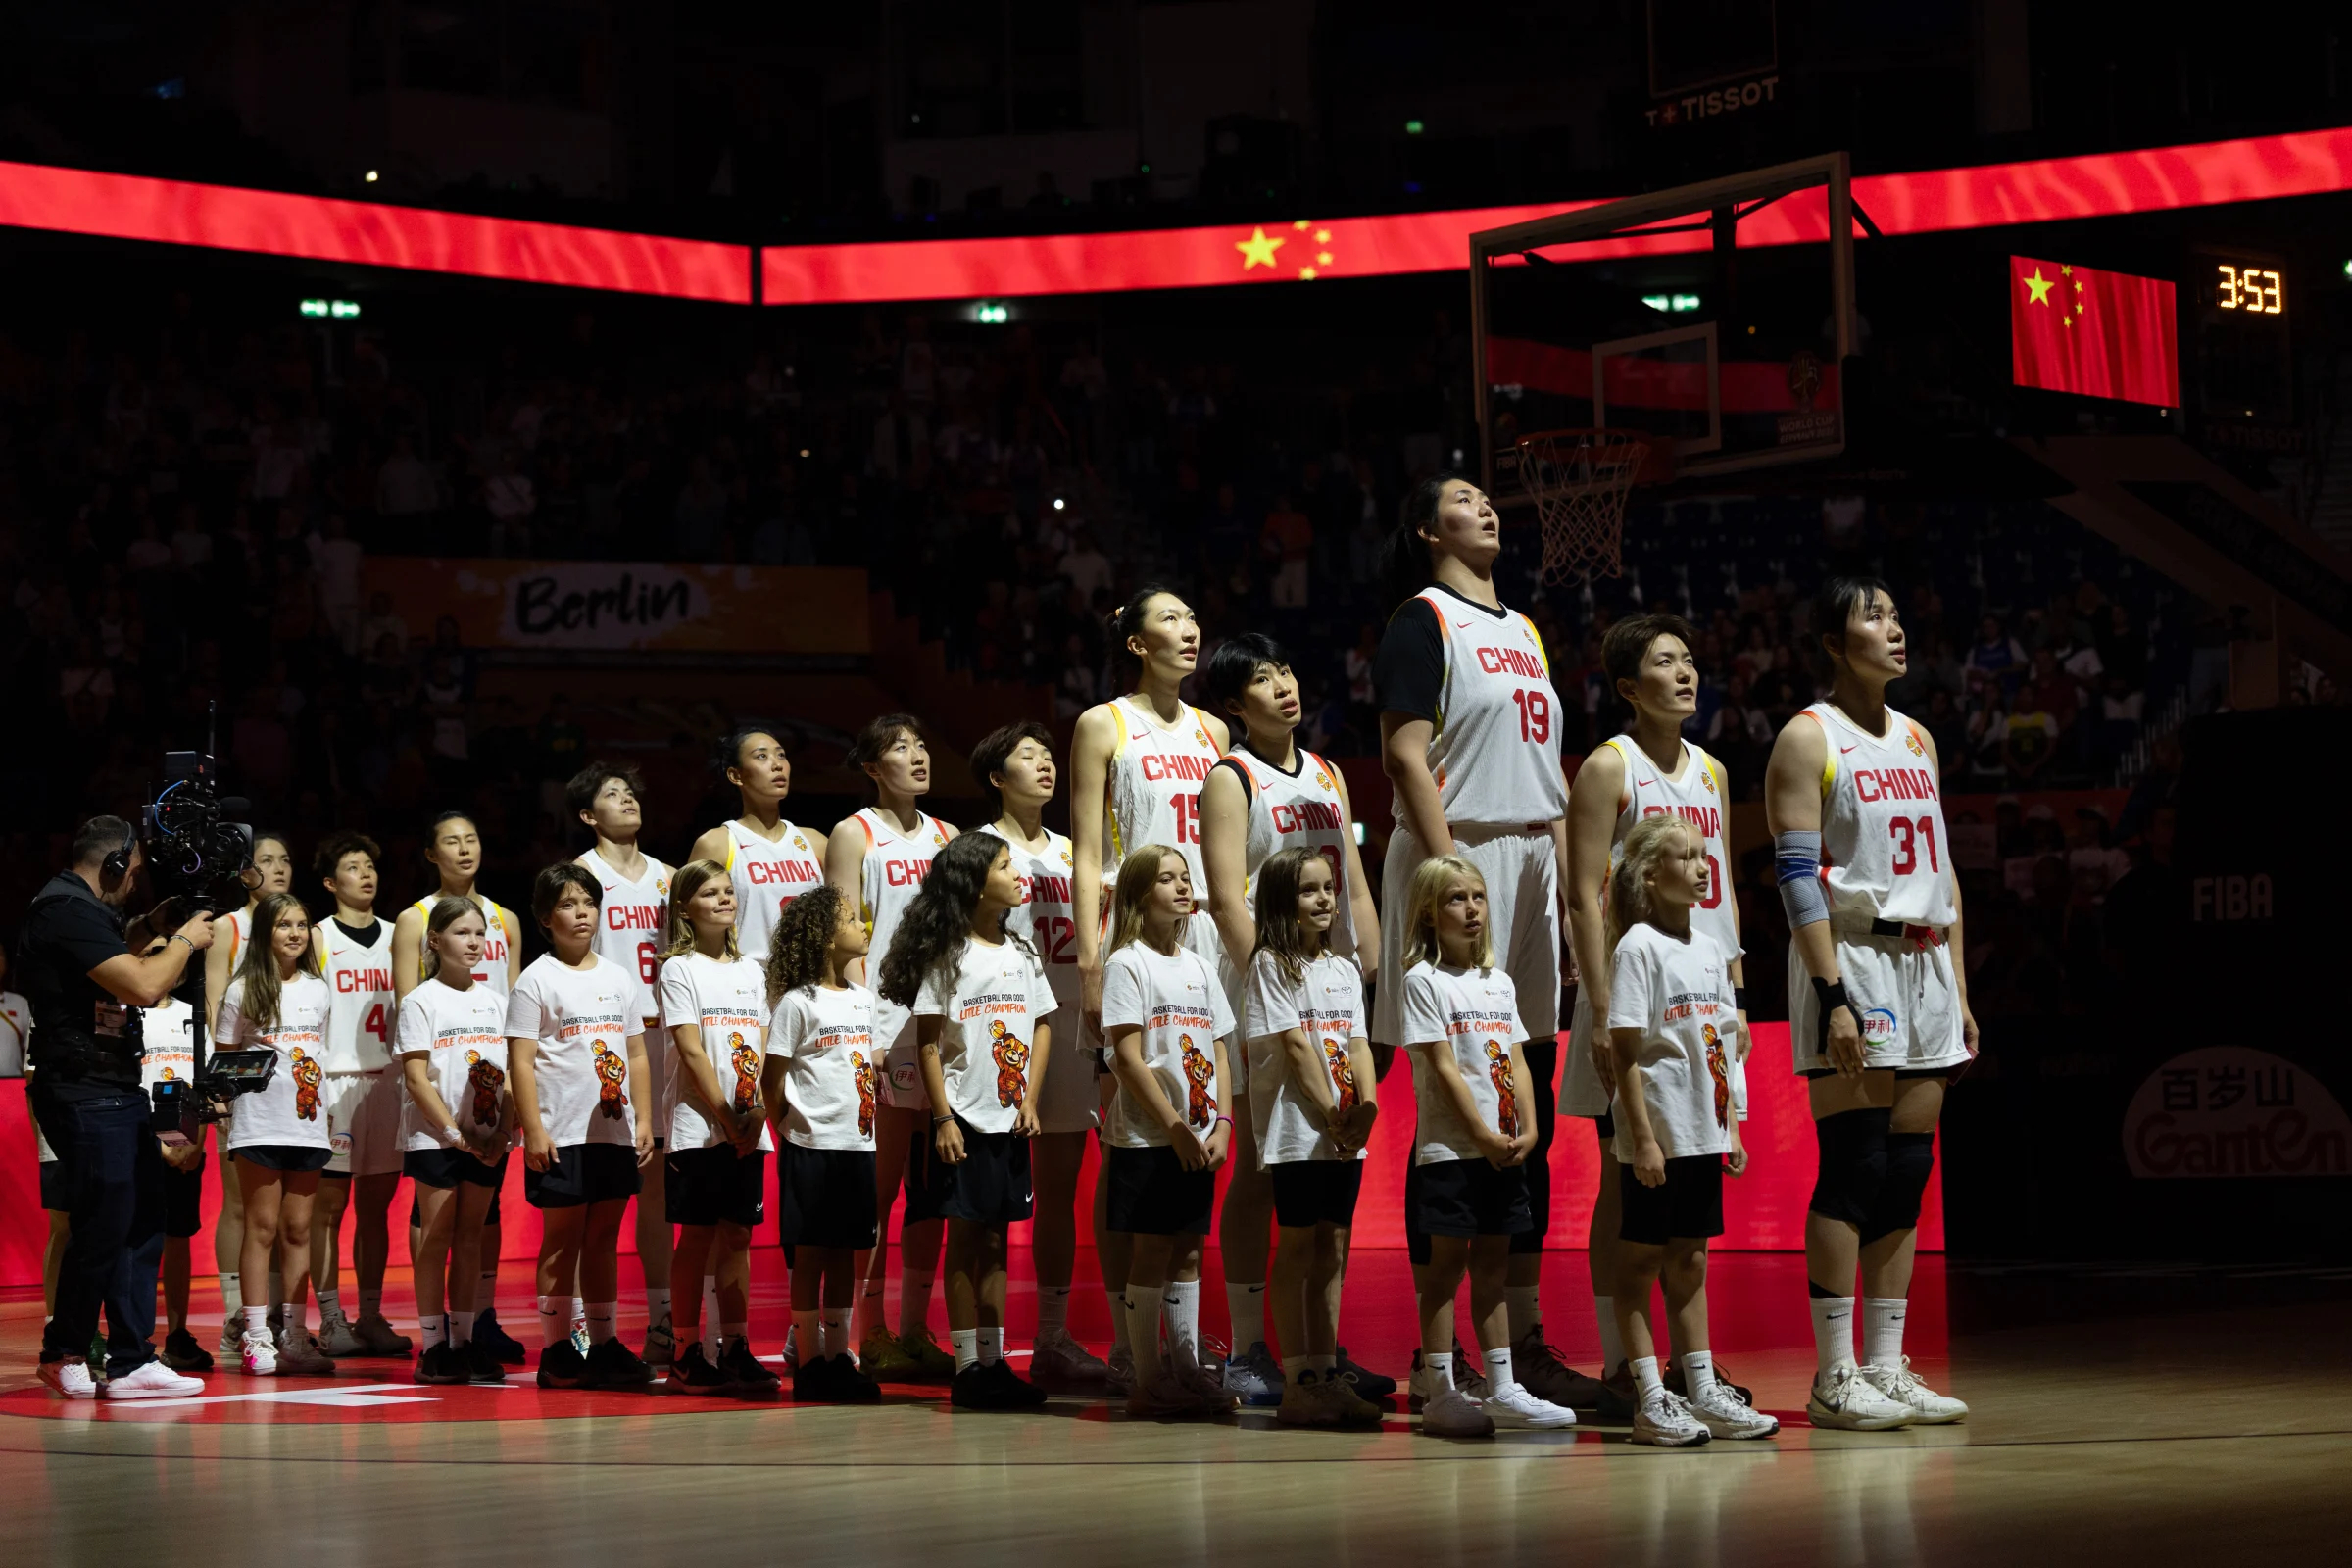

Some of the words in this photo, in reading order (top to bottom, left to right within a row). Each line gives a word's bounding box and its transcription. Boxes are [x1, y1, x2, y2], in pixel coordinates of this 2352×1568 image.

[1681, 75, 1780, 122] TISSOT
[2218, 265, 2282, 315] 3:53
[516, 572, 689, 633] Berlin
[1476, 647, 1549, 682] CHINA
[1512, 688, 1550, 745] 19
[1854, 768, 1938, 803] CHINA
[1271, 802, 1344, 834] CHINA
[1889, 815, 1938, 875] 31
[747, 860, 820, 885] CHINA
[886, 859, 933, 887] CHI
[2193, 872, 2274, 922] FIBA
[1033, 916, 1077, 964] 12
[637, 942, 658, 985] 6
[963, 994, 1001, 1007] BASKETBALL
[959, 1005, 982, 1021] LITTLE
[984, 1004, 1026, 1014] CHAMPION
[1187, 1006, 1199, 1015] FOR
[1199, 1007, 1209, 1016] GOO
[1326, 1009, 1340, 1019] FOR
[1664, 1003, 1693, 1022] LITTLE
[365, 1004, 387, 1043] 4
[562, 1016, 599, 1027] BASKETBALL
[702, 1016, 718, 1027] ITTLE
[721, 1016, 760, 1029] CHAMPION
[819, 1025, 855, 1036] BASKETBALL
[1172, 1014, 1211, 1029] CHAMPION
[1446, 1021, 1471, 1036] LITTLE
[282, 1032, 320, 1043] CHAMPION
[437, 1027, 472, 1038] BASKETBALL
[559, 1025, 581, 1039] LITTLE
[583, 1023, 624, 1034] CHAMPION
[146, 1046, 169, 1054] KETBALL
[433, 1037, 455, 1049] LITTLE
[458, 1034, 503, 1045] CHAMPIONS
[815, 1034, 841, 1048] LITTLE
[155, 1053, 194, 1063] CHAMPION
[2161, 1064, 2294, 1111] 百岁山
